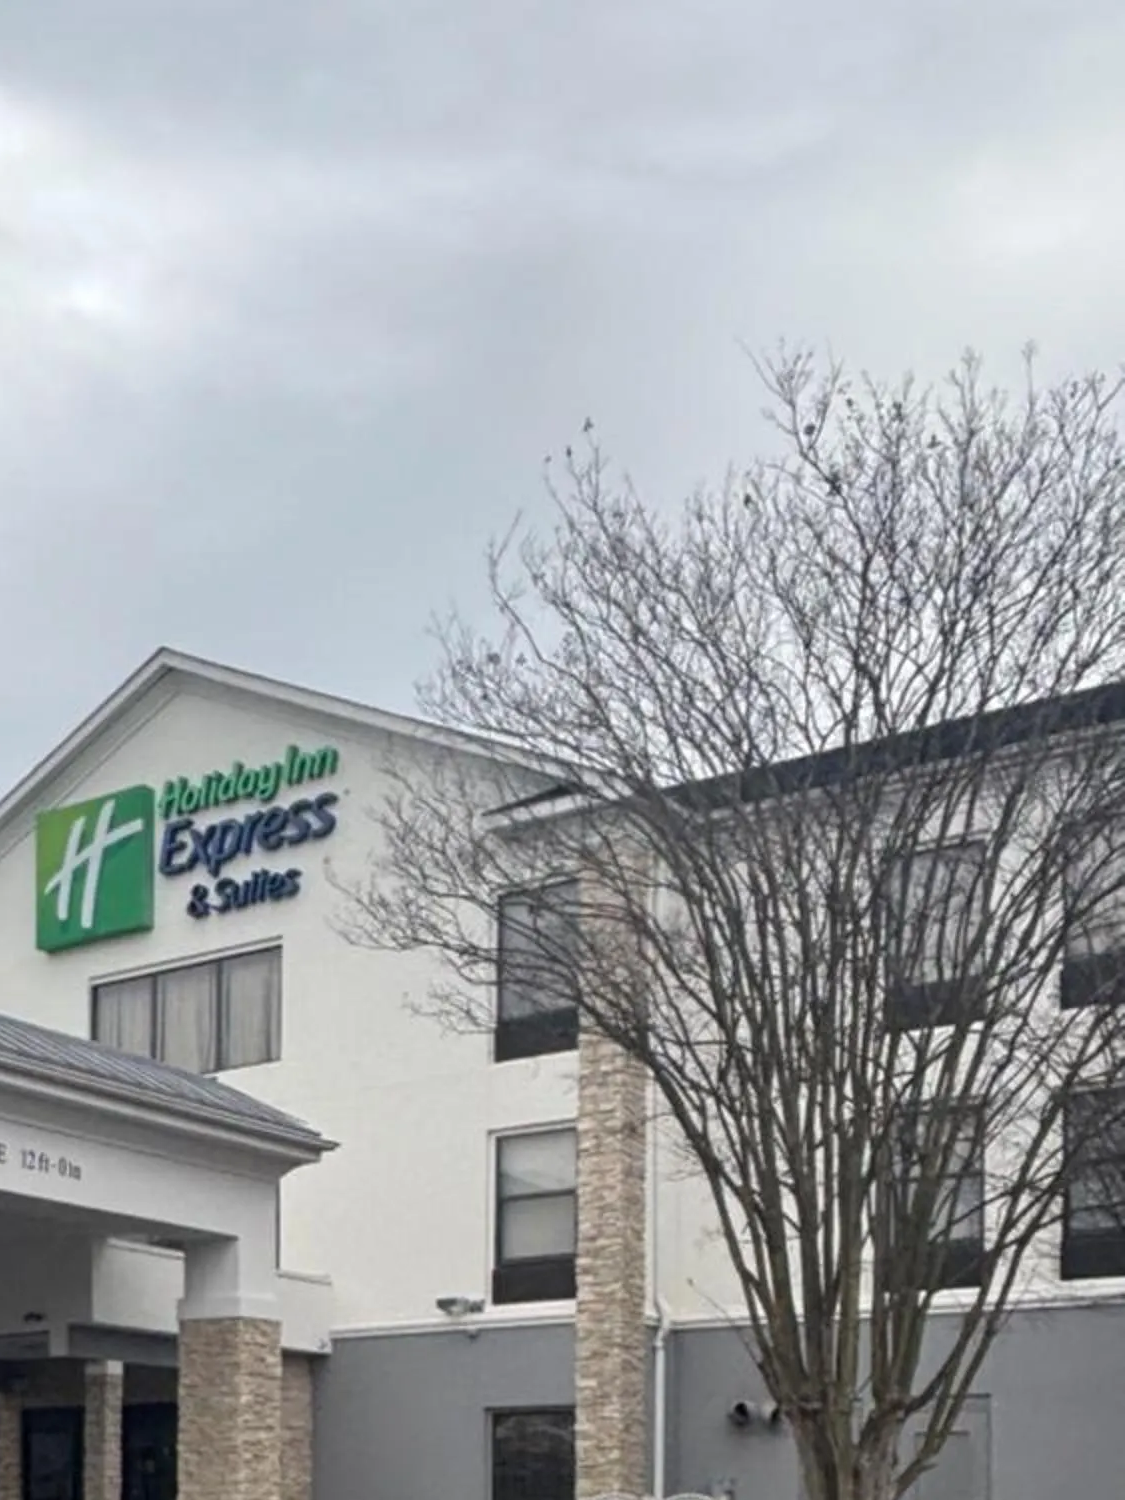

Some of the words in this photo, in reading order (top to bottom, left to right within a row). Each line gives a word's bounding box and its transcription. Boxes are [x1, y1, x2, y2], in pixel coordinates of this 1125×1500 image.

[159, 761, 282, 818] Holiday
[284, 745, 339, 785] Inn
[159, 792, 339, 877] Express
[187, 884, 210, 919] &
[210, 868, 302, 913] Suites
